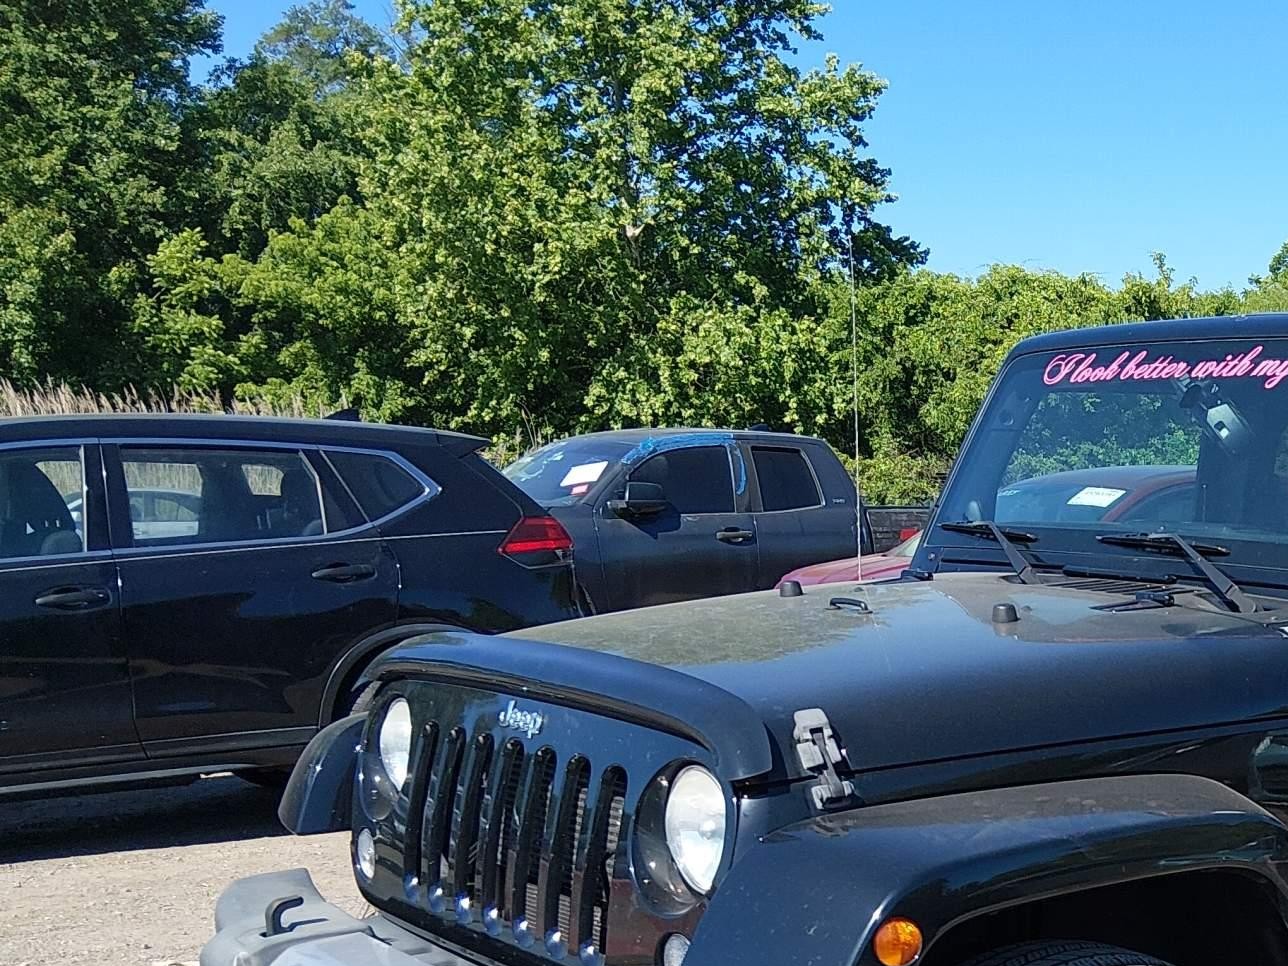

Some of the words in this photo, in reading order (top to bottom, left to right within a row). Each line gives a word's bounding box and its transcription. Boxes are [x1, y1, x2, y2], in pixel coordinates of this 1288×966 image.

[1042, 352, 1081, 386] I
[1072, 354, 1121, 384] look
[1119, 350, 1188, 380] better
[1190, 345, 1263, 379] with
[498, 700, 544, 737] Jeep
